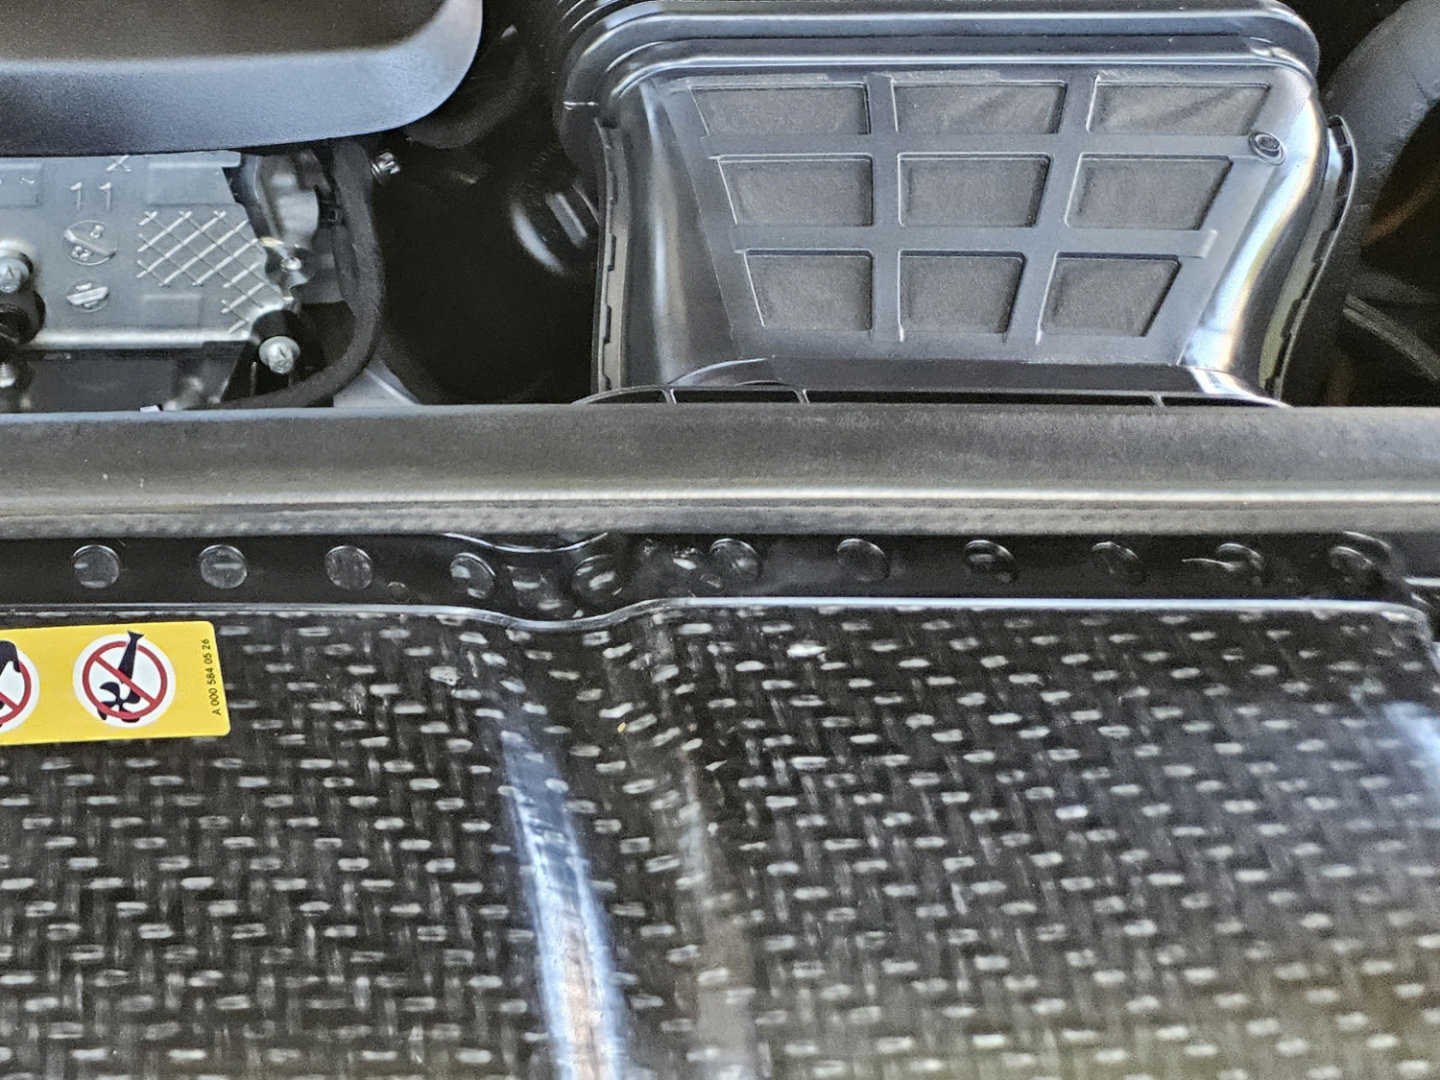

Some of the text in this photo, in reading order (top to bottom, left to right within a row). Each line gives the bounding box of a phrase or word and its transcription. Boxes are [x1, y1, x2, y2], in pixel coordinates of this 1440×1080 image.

[201, 638, 222, 716] A 000 584 05 26
